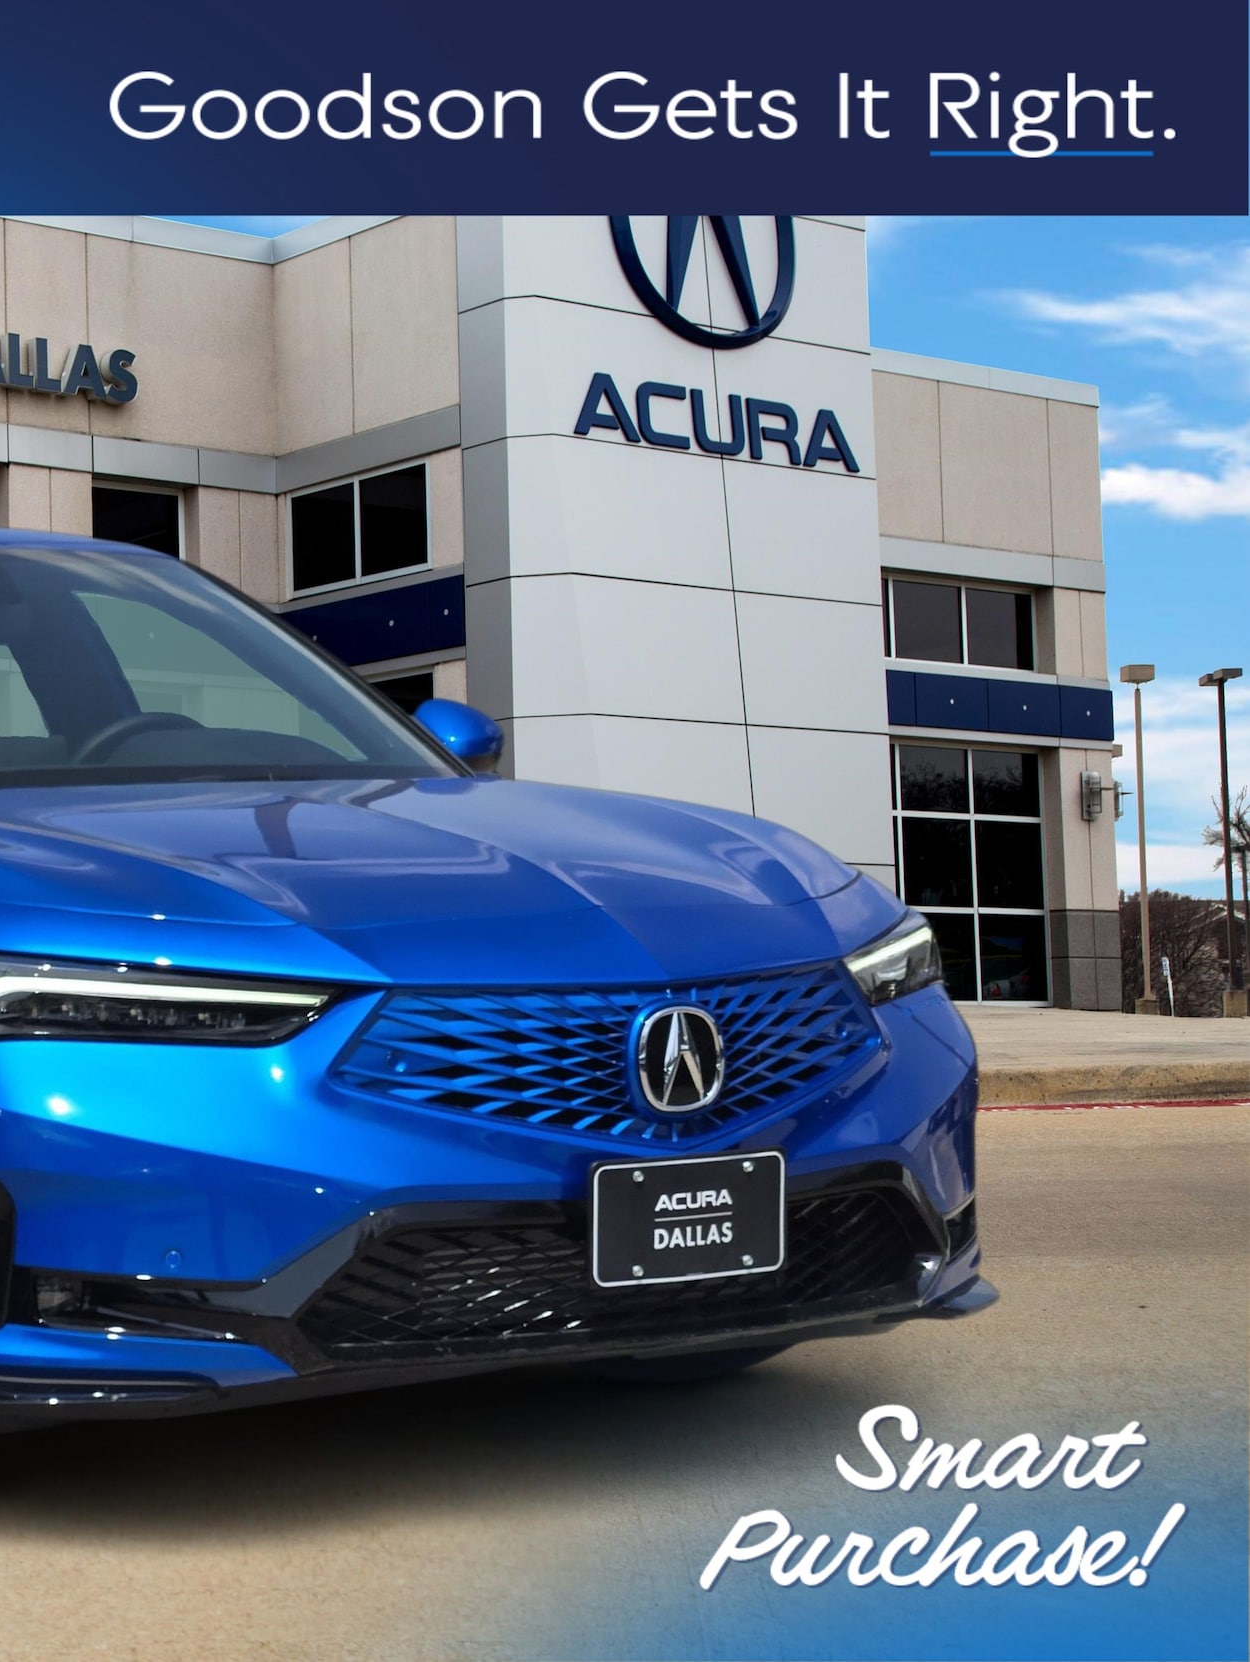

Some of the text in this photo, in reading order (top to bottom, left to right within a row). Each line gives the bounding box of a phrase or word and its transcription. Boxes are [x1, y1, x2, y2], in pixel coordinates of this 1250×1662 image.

[573, 371, 861, 473] ACURA
[653, 1188, 733, 1213] ACURA
[653, 1221, 734, 1250] DALLAS
